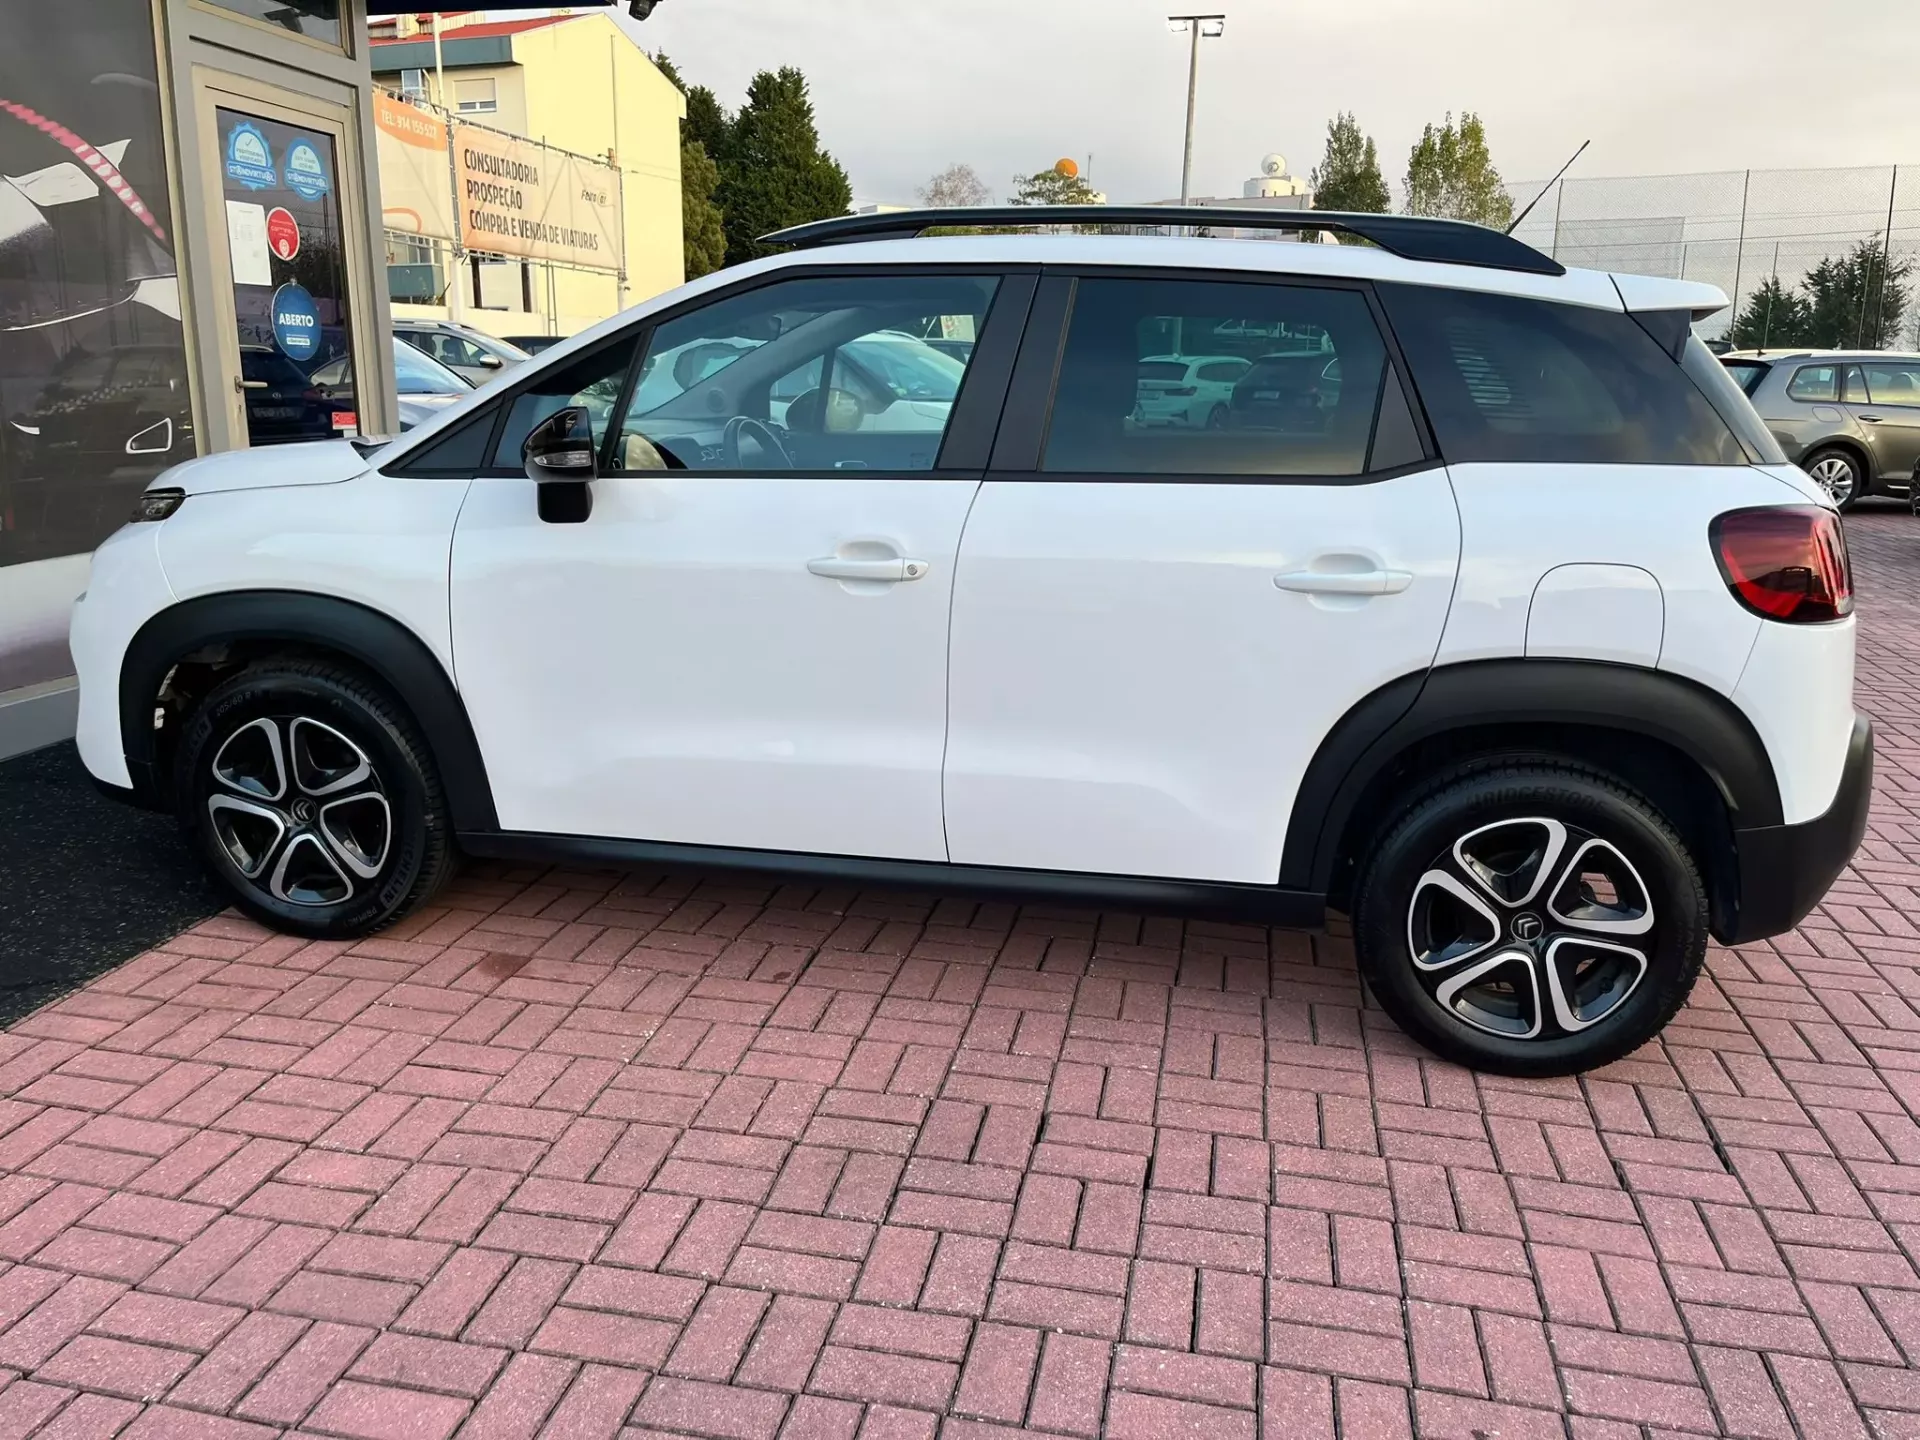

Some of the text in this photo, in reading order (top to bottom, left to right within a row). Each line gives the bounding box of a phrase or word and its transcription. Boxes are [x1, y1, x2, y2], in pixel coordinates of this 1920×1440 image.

[464, 148, 539, 187] CONSULTADORIA
[466, 179, 522, 211] PROSPEÇÃO
[469, 209, 599, 251] COMPRA E VENDA DE VIATURAS
[279, 312, 314, 328] ABERTO
